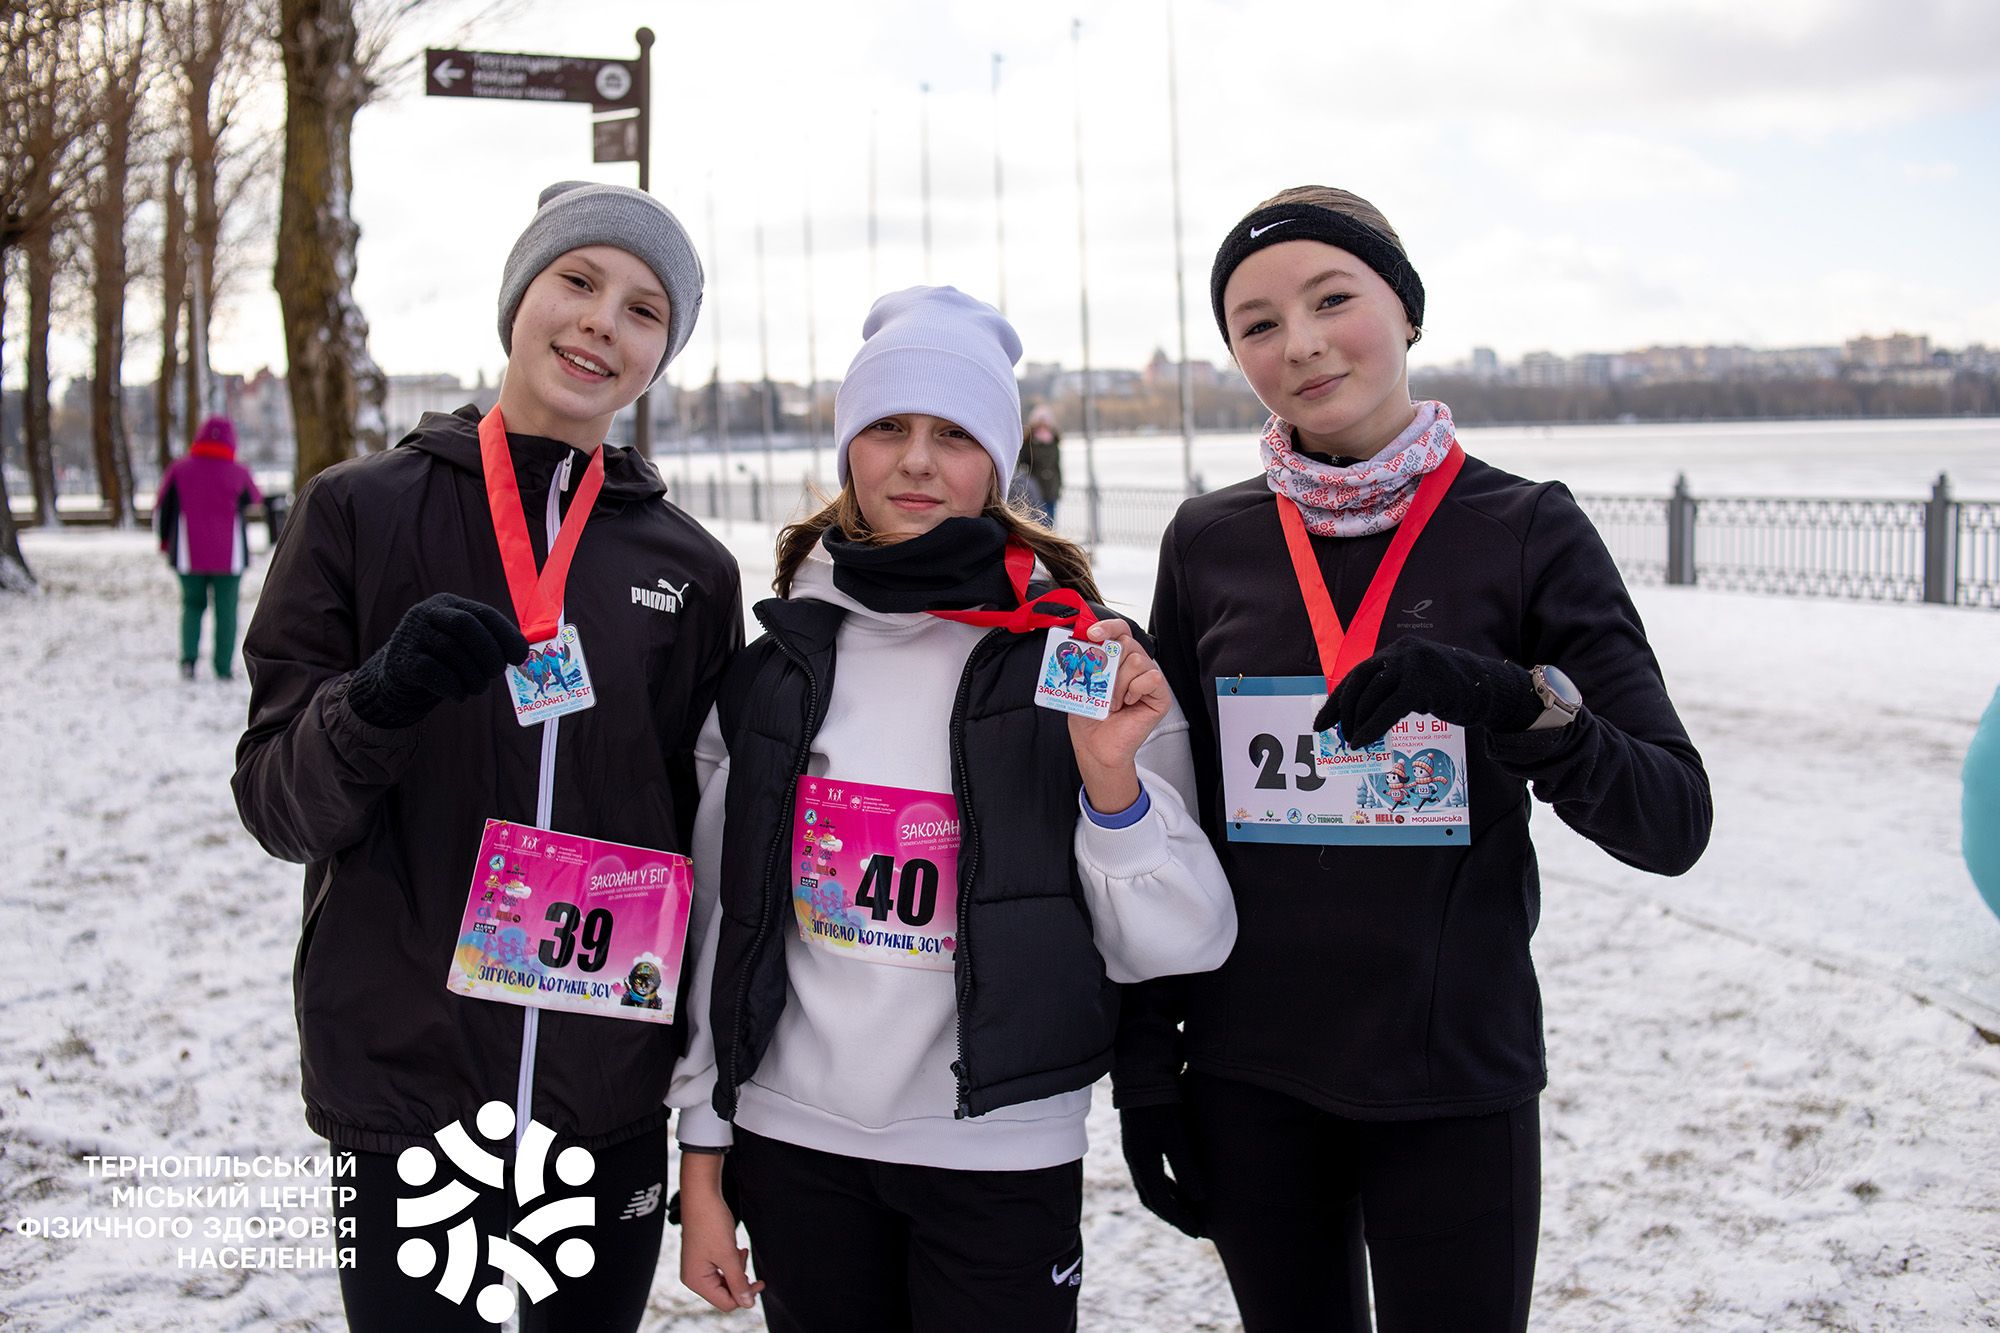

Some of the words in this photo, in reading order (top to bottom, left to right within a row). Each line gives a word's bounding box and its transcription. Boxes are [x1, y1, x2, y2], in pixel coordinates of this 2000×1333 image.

[1302, 488, 1329, 501] 2026
[1392, 501, 1410, 522] sion
[631, 586, 677, 614] PUMA
[516, 694, 565, 714] ЗАКОХАНІ
[575, 686, 591, 698] БІГ
[1038, 685, 1083, 702] ЗАКОХАНІ
[1094, 699, 1110, 707] БІГ
[1416, 720, 1424, 732] У
[1248, 732, 1327, 792] 25
[1316, 754, 1364, 766] ЗАКОХАНІ
[1376, 752, 1391, 762] БІГ
[1375, 813, 1394, 823] HELL
[1411, 814, 1462, 824] моршинська
[901, 819, 960, 840] ЗАКОХАН
[590, 870, 638, 891] ЗАКОХАНІ
[640, 869, 648, 884] У
[649, 868, 669, 884] БІГ
[855, 854, 939, 927] 40
[537, 901, 614, 973] 39
[811, 919, 855, 942] ЗІГРІЄМО
[858, 929, 915, 950] КОТИКІВ
[477, 965, 535, 989] ЗІГРІЄМО
[538, 975, 588, 995] КОТИКІВ
